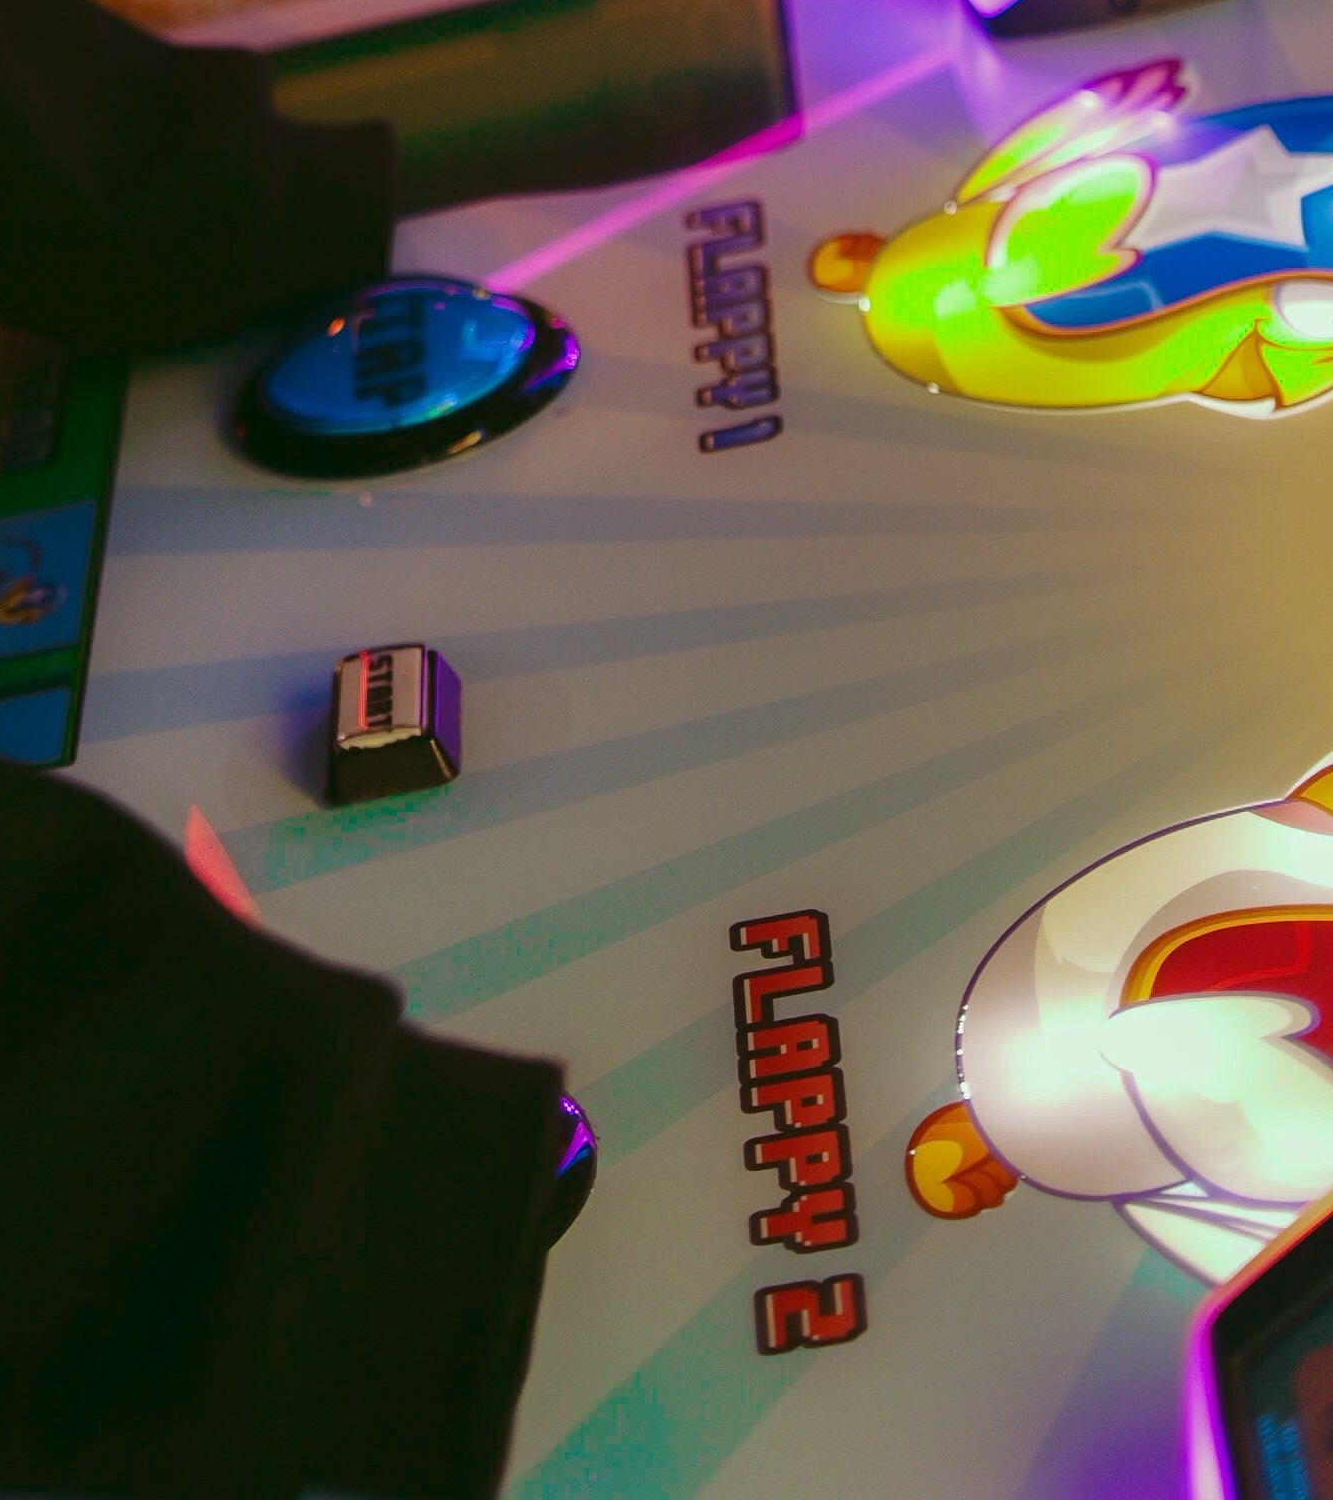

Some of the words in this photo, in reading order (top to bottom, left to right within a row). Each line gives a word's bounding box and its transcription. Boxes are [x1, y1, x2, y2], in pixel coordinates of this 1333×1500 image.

[685, 199, 779, 409] FLAPPY
[729, 908, 859, 1254] FLAPPY
[753, 1272, 868, 1356] 2
